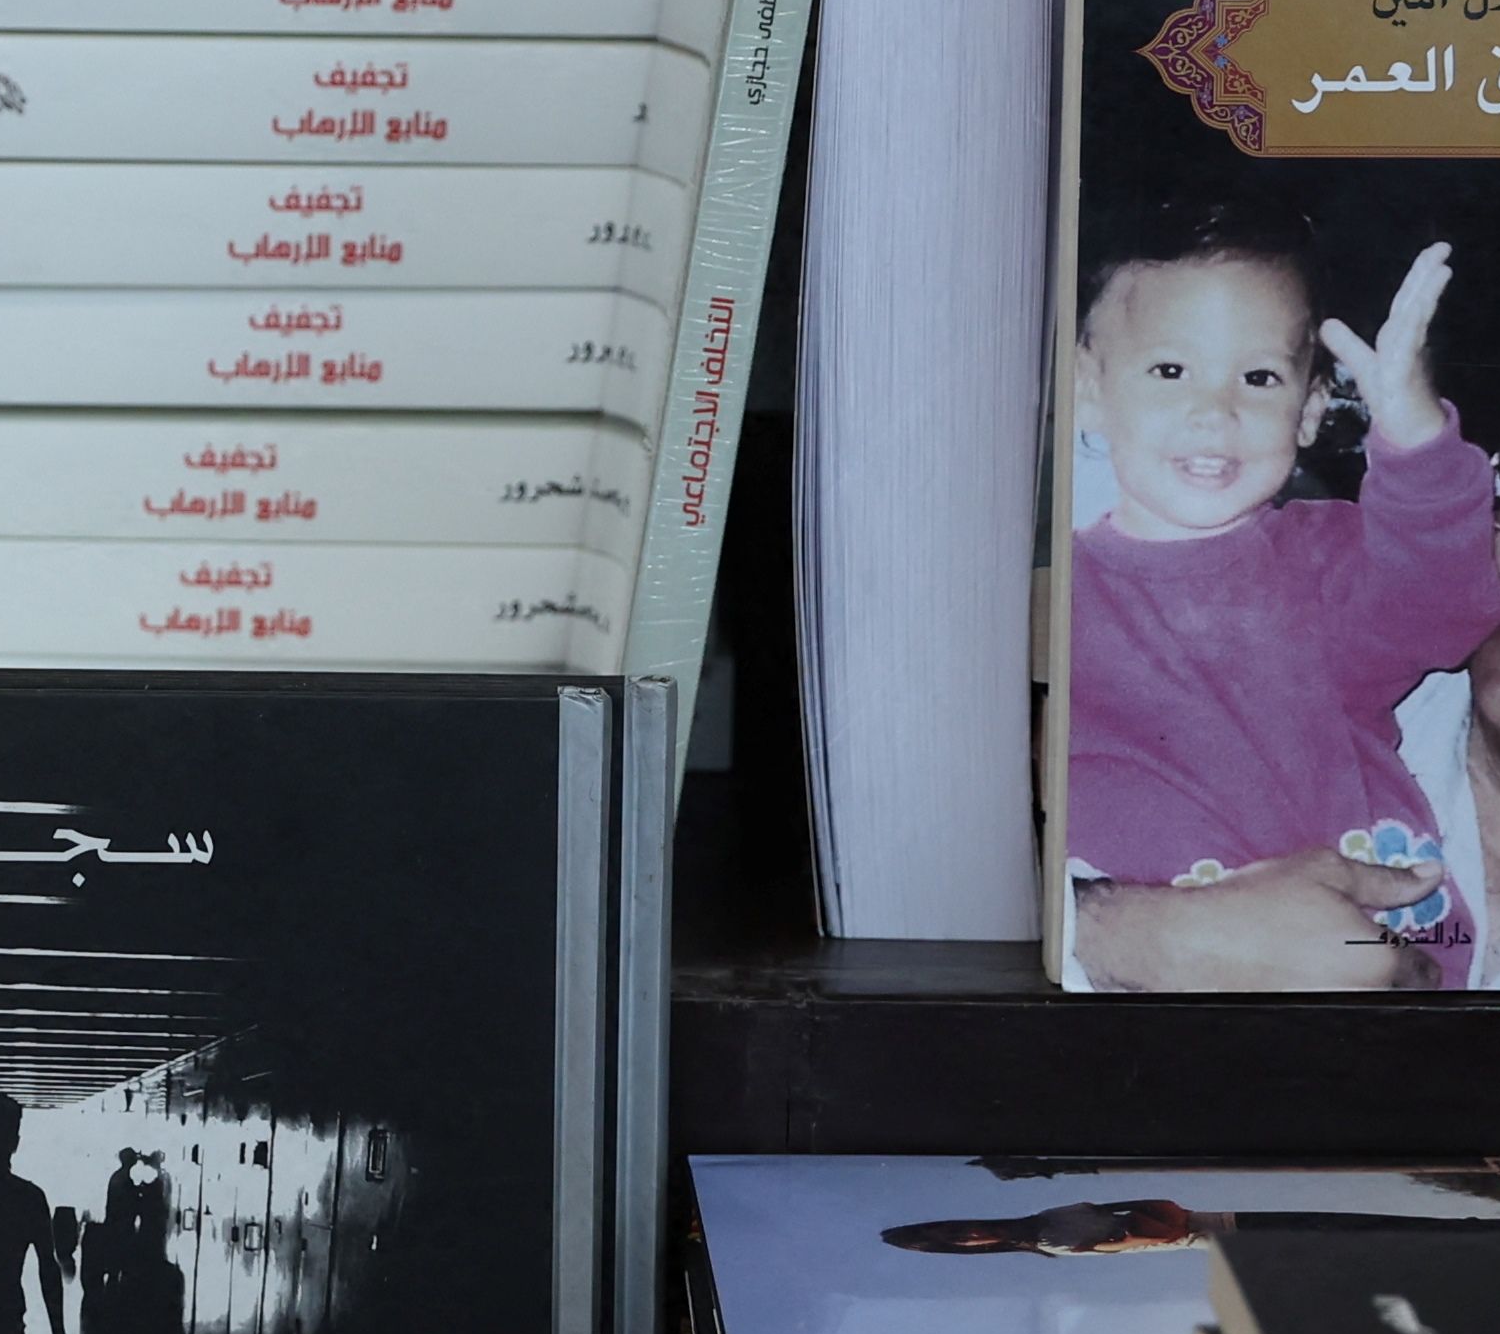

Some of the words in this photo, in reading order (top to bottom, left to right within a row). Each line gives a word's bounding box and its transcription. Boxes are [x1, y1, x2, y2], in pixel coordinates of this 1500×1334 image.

[313, 64, 409, 92] تجفيف
[745, 43, 770, 106] حجازي
[1290, 44, 1453, 114] العمر
[385, 111, 447, 143] منابع
[267, 186, 363, 214] تجفيف
[342, 235, 403, 267] منابع
[247, 306, 343, 335] تجفيف
[706, 296, 736, 387] التخلف
[322, 354, 382, 385] منابع
[183, 444, 278, 474] تجفيف
[681, 388, 722, 529] الاجتماعي
[257, 491, 317, 522] منابع
[180, 562, 273, 591] تجفيف
[252, 608, 312, 639] منابع
